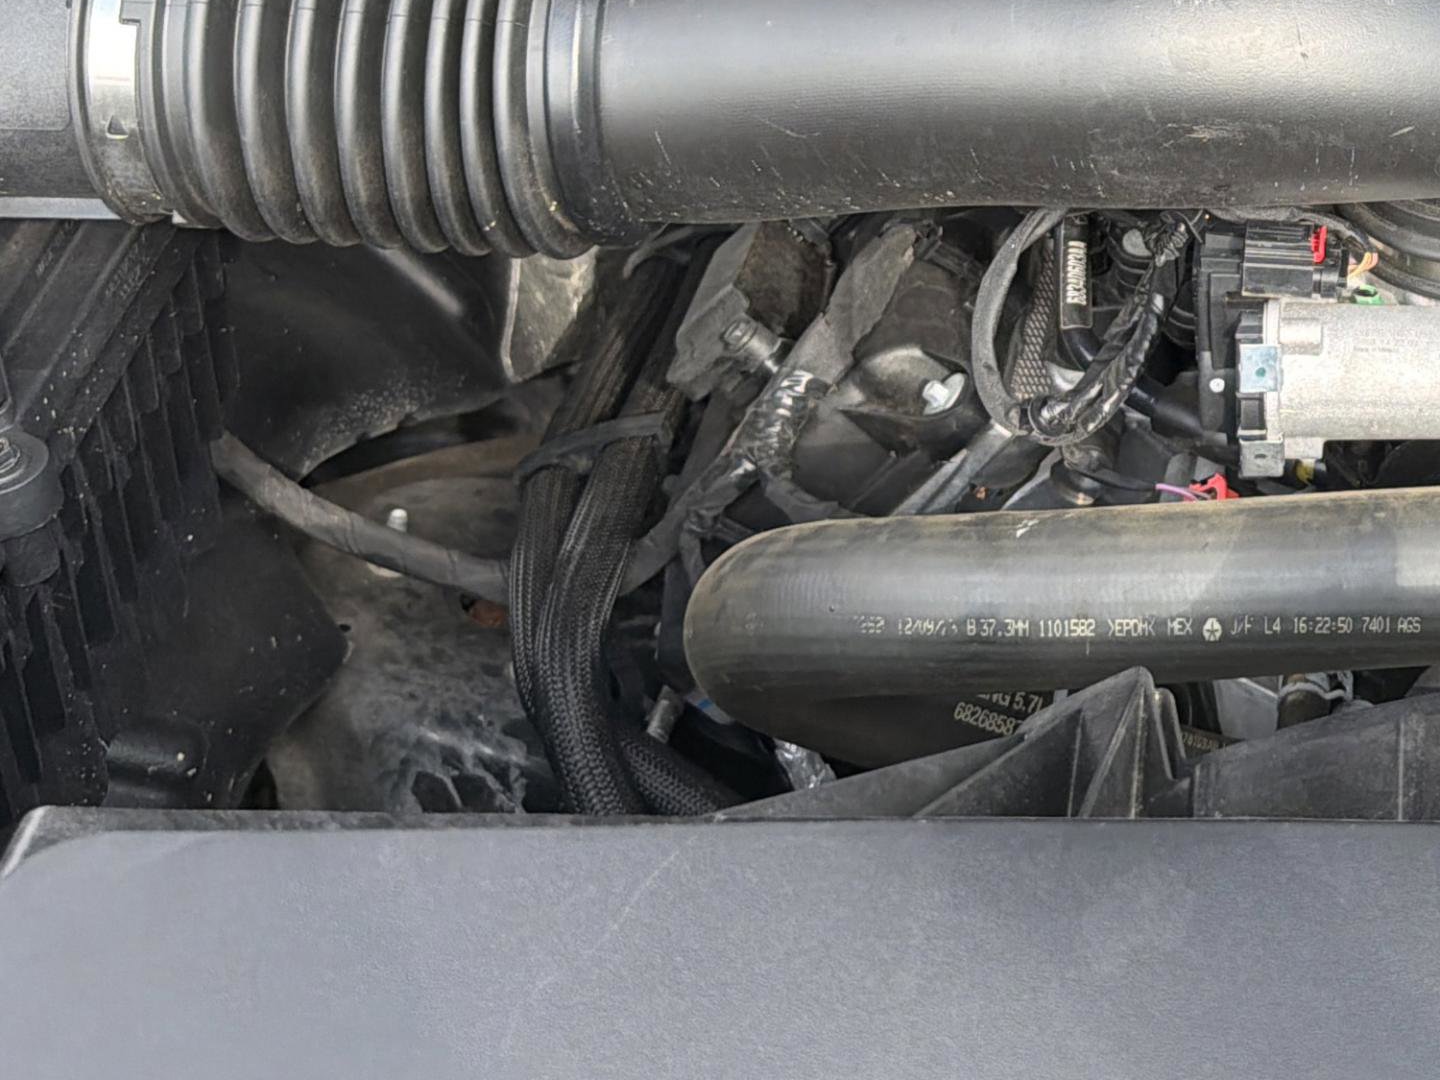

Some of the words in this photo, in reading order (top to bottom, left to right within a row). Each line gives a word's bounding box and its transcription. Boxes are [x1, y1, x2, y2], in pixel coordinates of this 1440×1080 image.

[1039, 618, 1096, 637] 1101582
[1168, 618, 1193, 635] MEX
[1264, 617, 1281, 634] L4
[1293, 616, 1353, 634] 16:22:50
[1361, 617, 1392, 633] 7401
[1398, 616, 1422, 633] AGS
[953, 701, 1024, 736] 6826858
